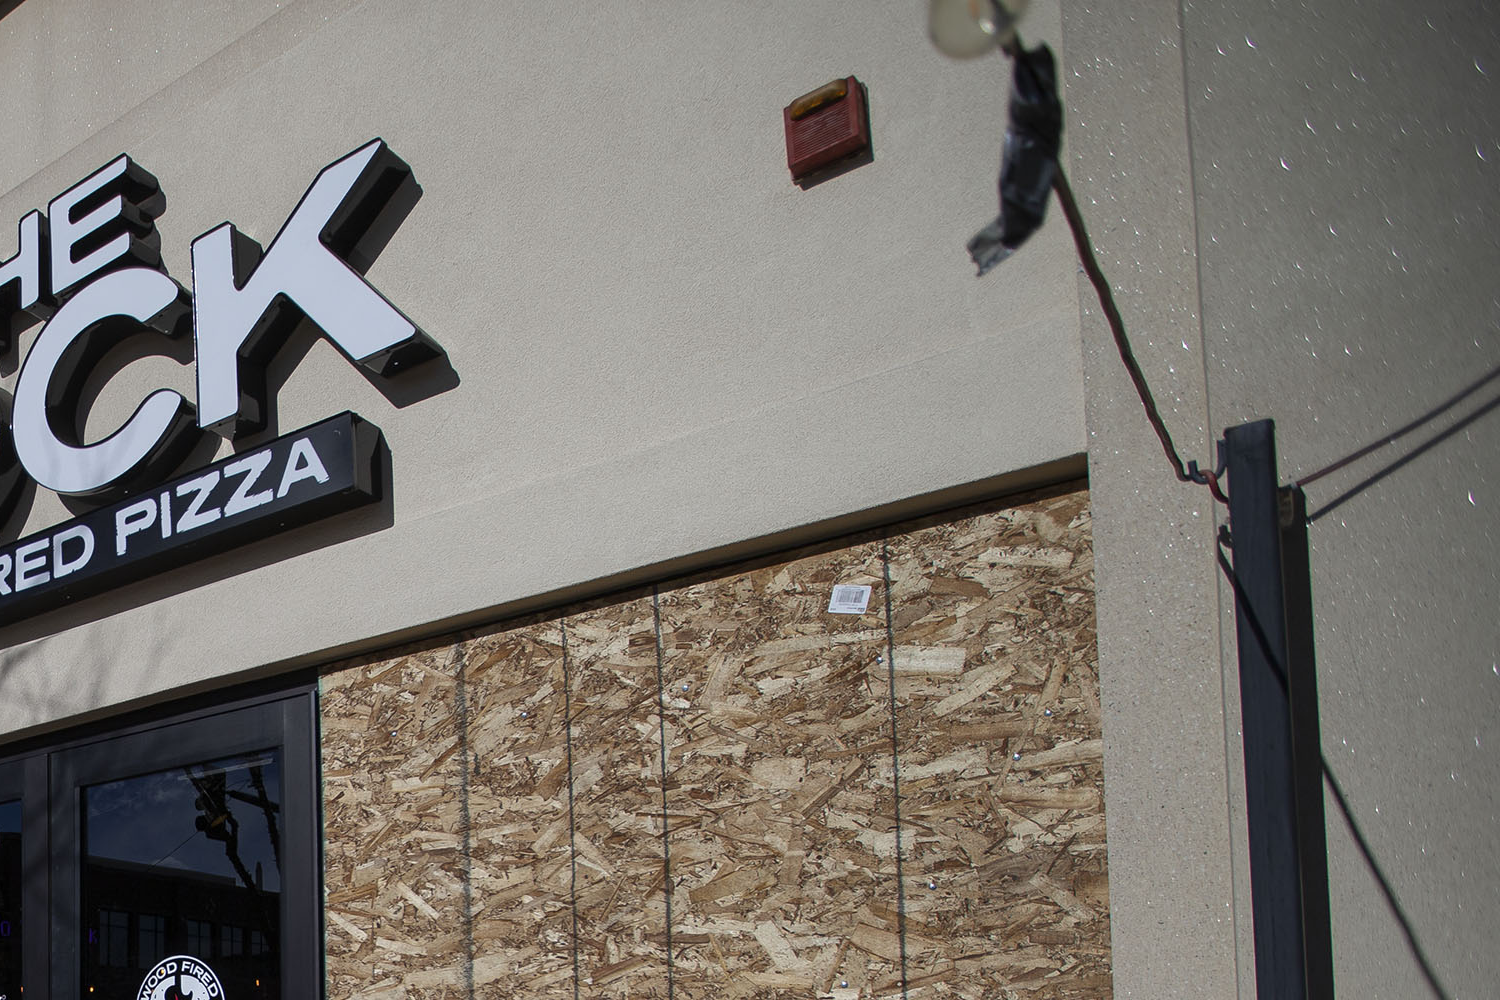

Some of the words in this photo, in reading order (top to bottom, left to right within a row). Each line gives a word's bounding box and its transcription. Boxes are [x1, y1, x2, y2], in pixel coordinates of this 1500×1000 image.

[116, 438, 329, 556] PIZZA
[140, 961, 178, 1000] WOOD
[181, 961, 219, 998] FIRED
